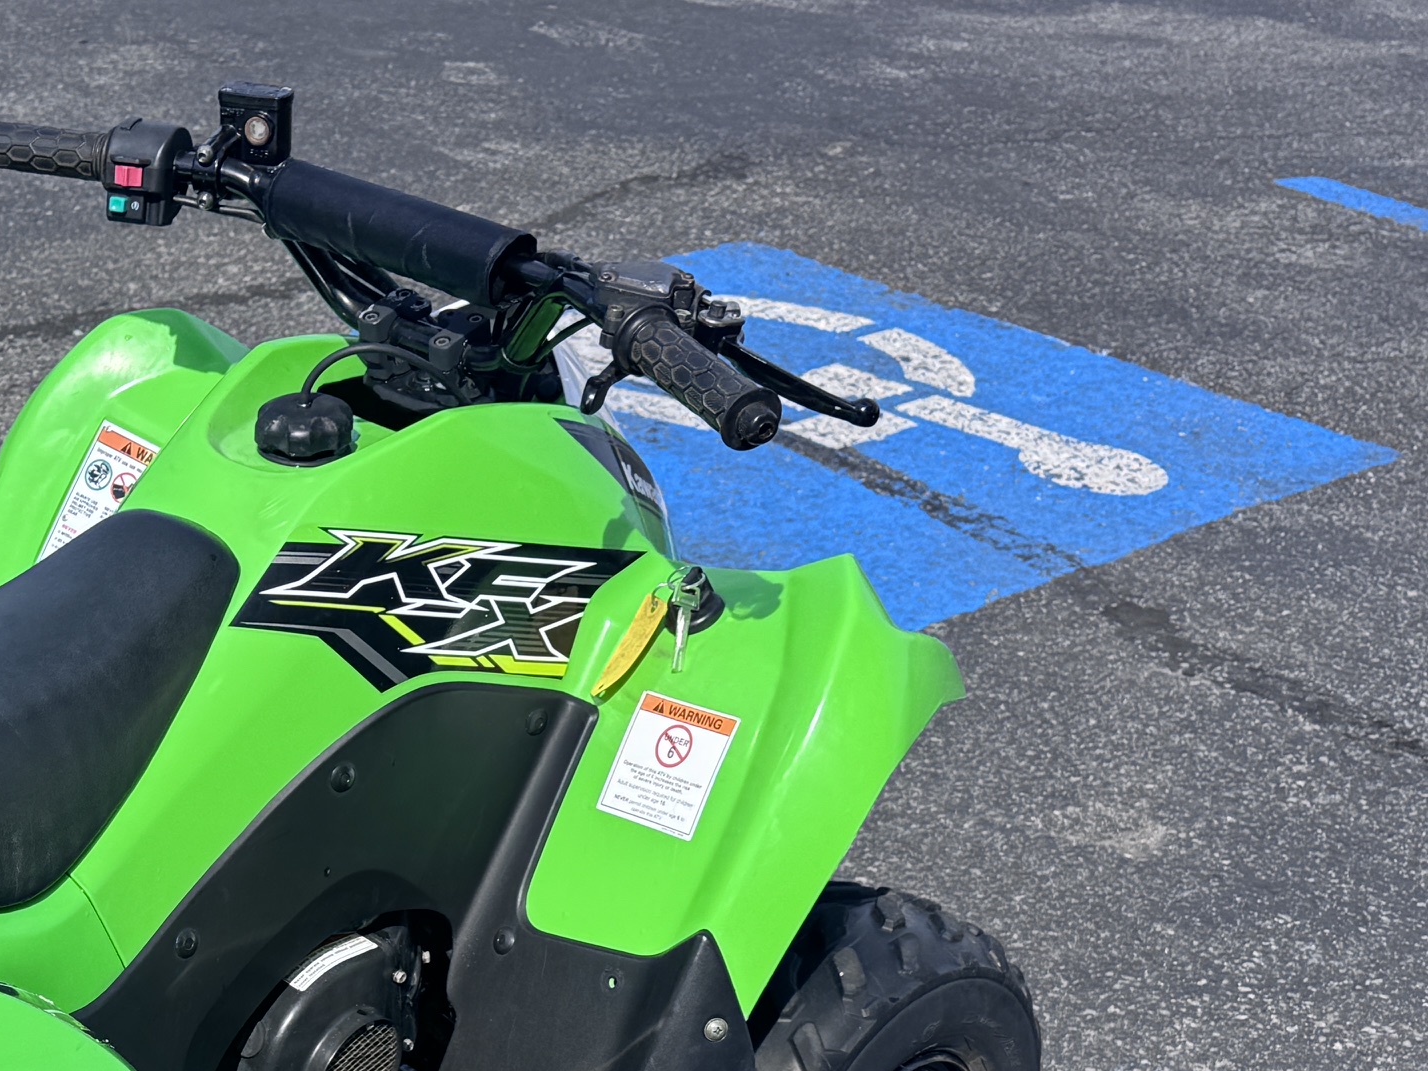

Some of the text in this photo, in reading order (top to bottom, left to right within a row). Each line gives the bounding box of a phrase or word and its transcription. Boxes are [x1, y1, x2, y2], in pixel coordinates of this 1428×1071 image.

[258, 528, 597, 662] KFX
[667, 704, 724, 731] WARNING
[666, 746, 677, 760] 6
